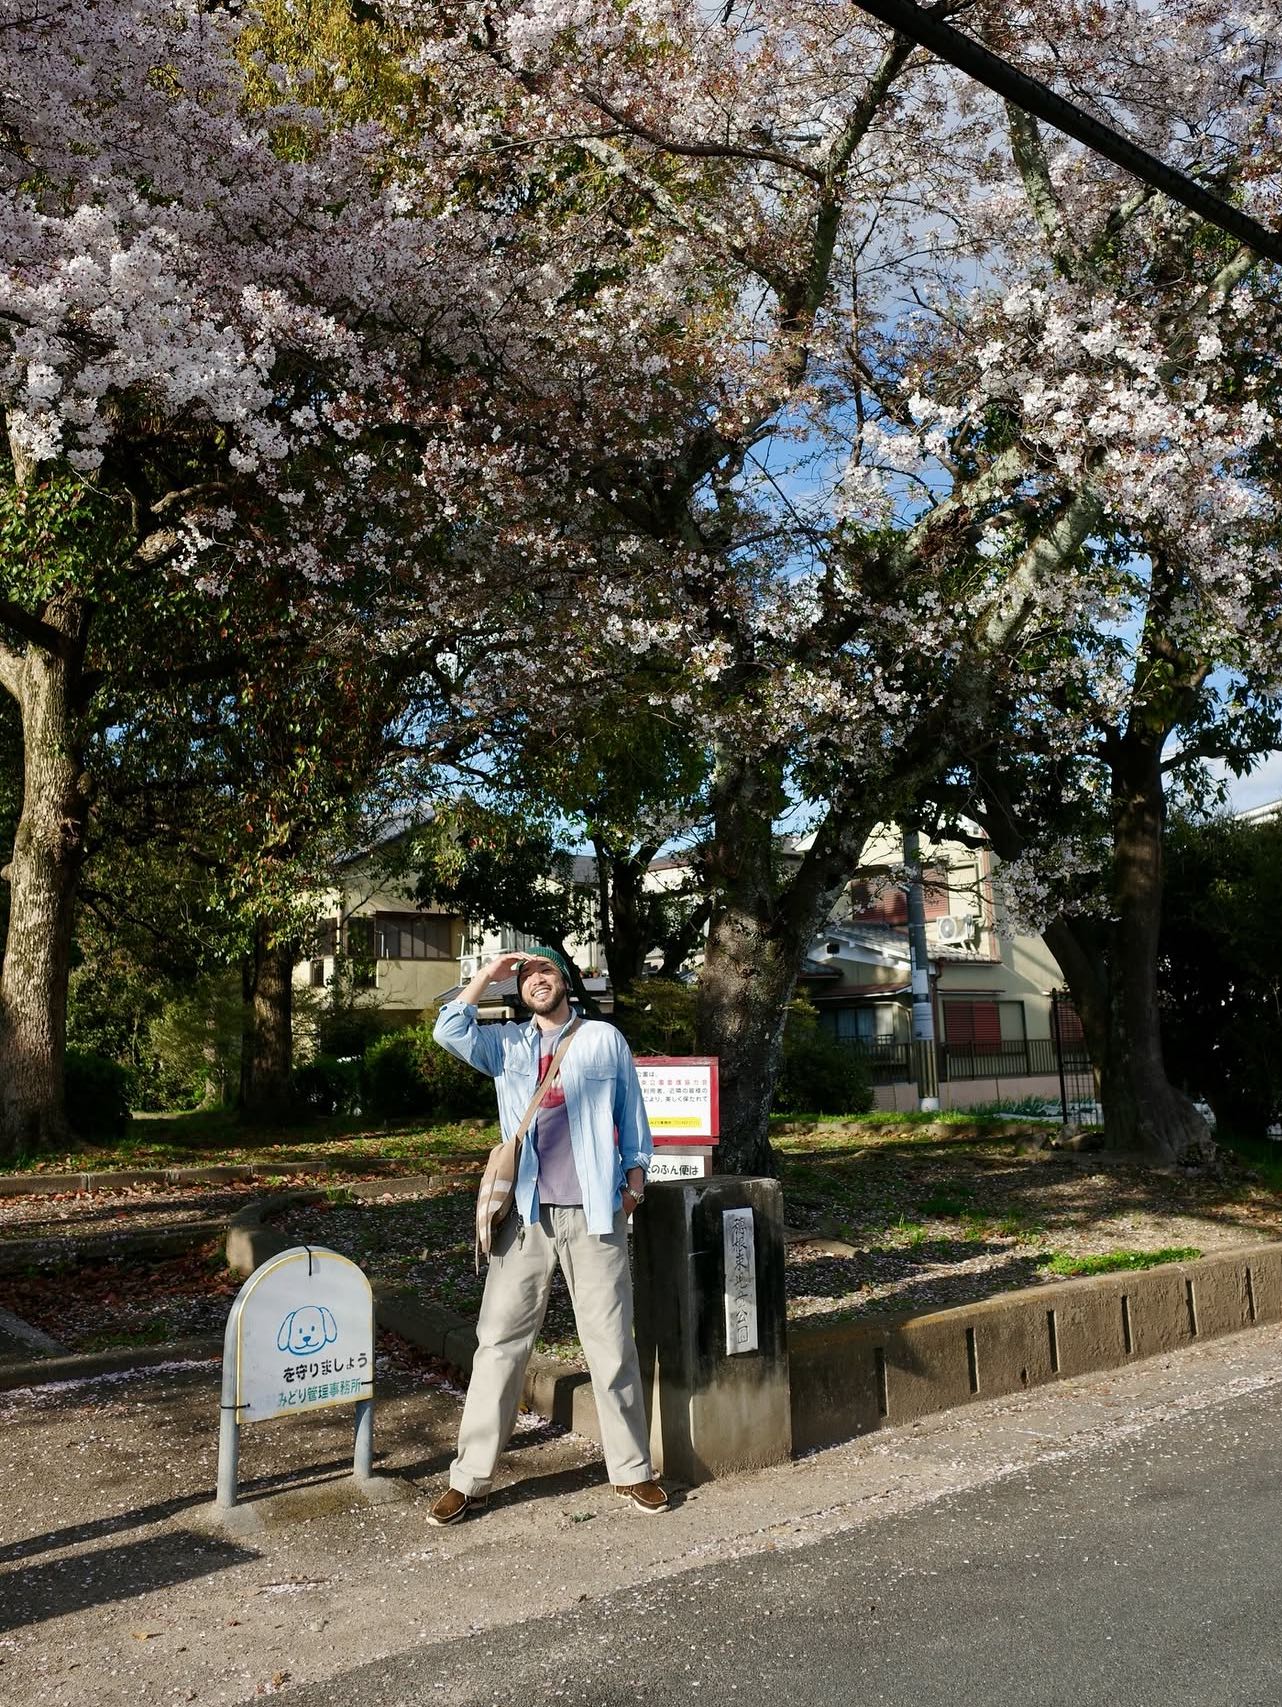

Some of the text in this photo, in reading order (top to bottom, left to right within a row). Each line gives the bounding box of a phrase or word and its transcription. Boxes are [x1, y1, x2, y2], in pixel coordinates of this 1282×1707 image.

[283, 1352, 368, 1383] を守りましょう
[278, 1378, 361, 1407] みどり管理事務所
